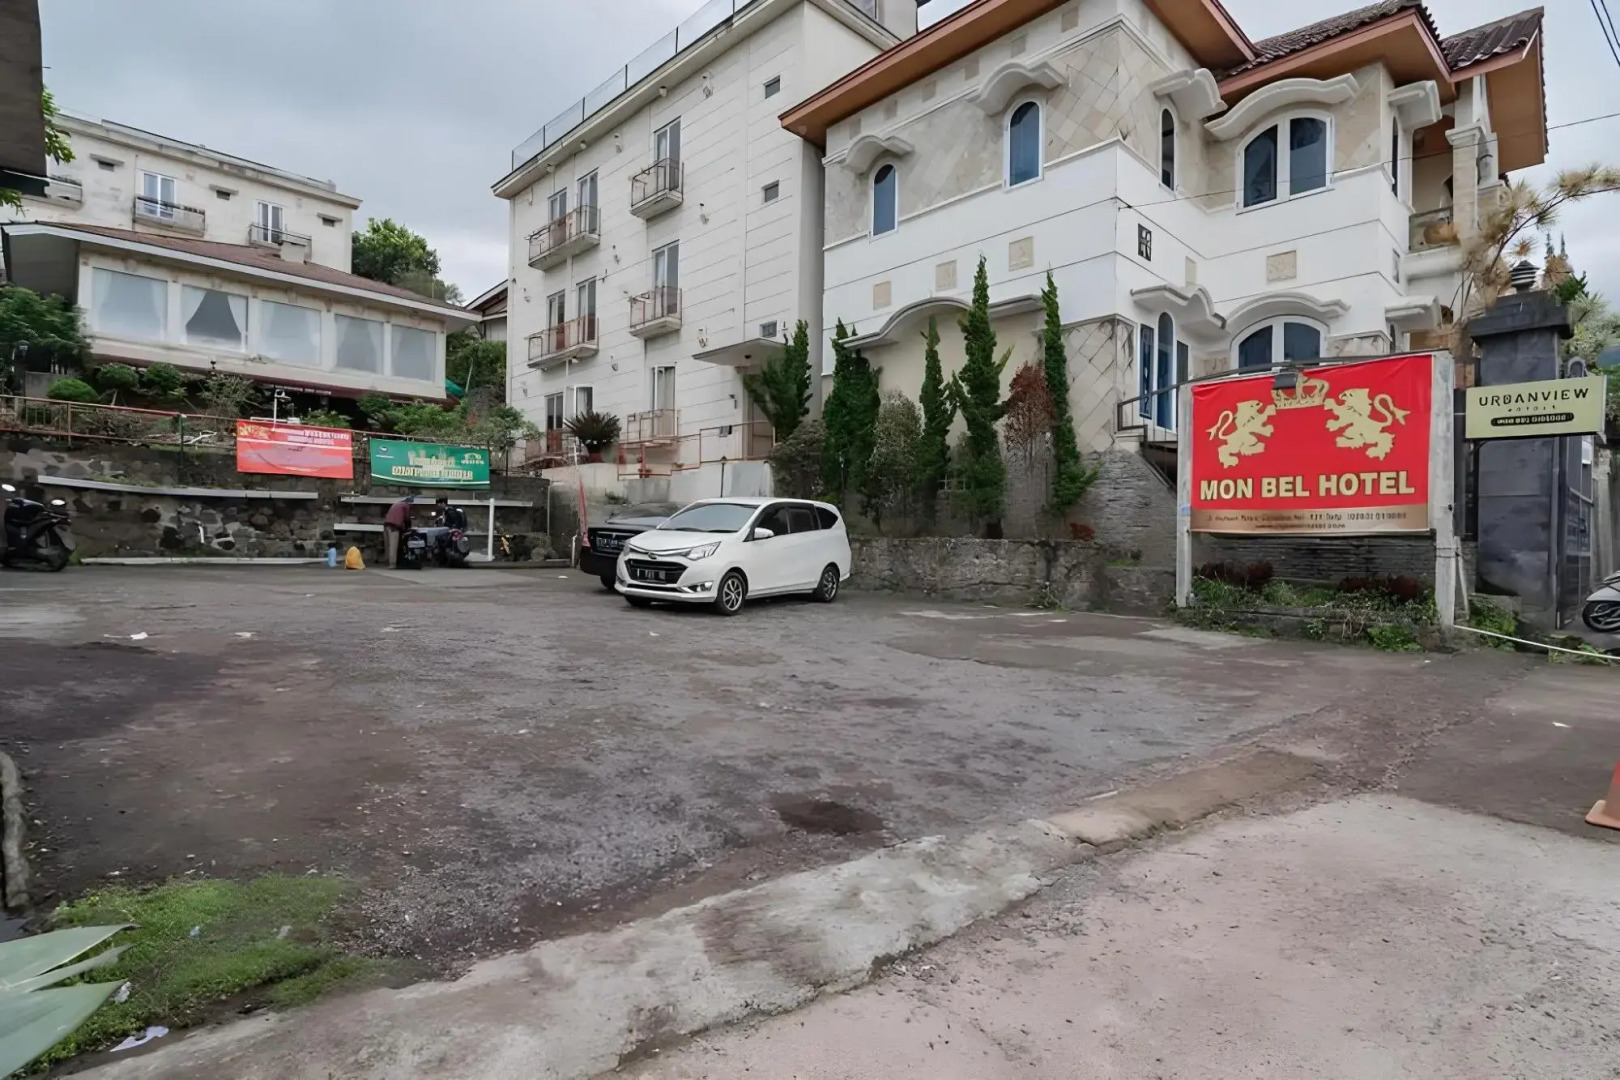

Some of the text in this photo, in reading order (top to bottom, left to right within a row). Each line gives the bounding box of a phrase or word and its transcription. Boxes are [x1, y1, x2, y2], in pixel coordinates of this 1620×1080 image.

[1479, 387, 1589, 407] URBANVIEW
[1200, 470, 1415, 500] MON BEL HOTEL
